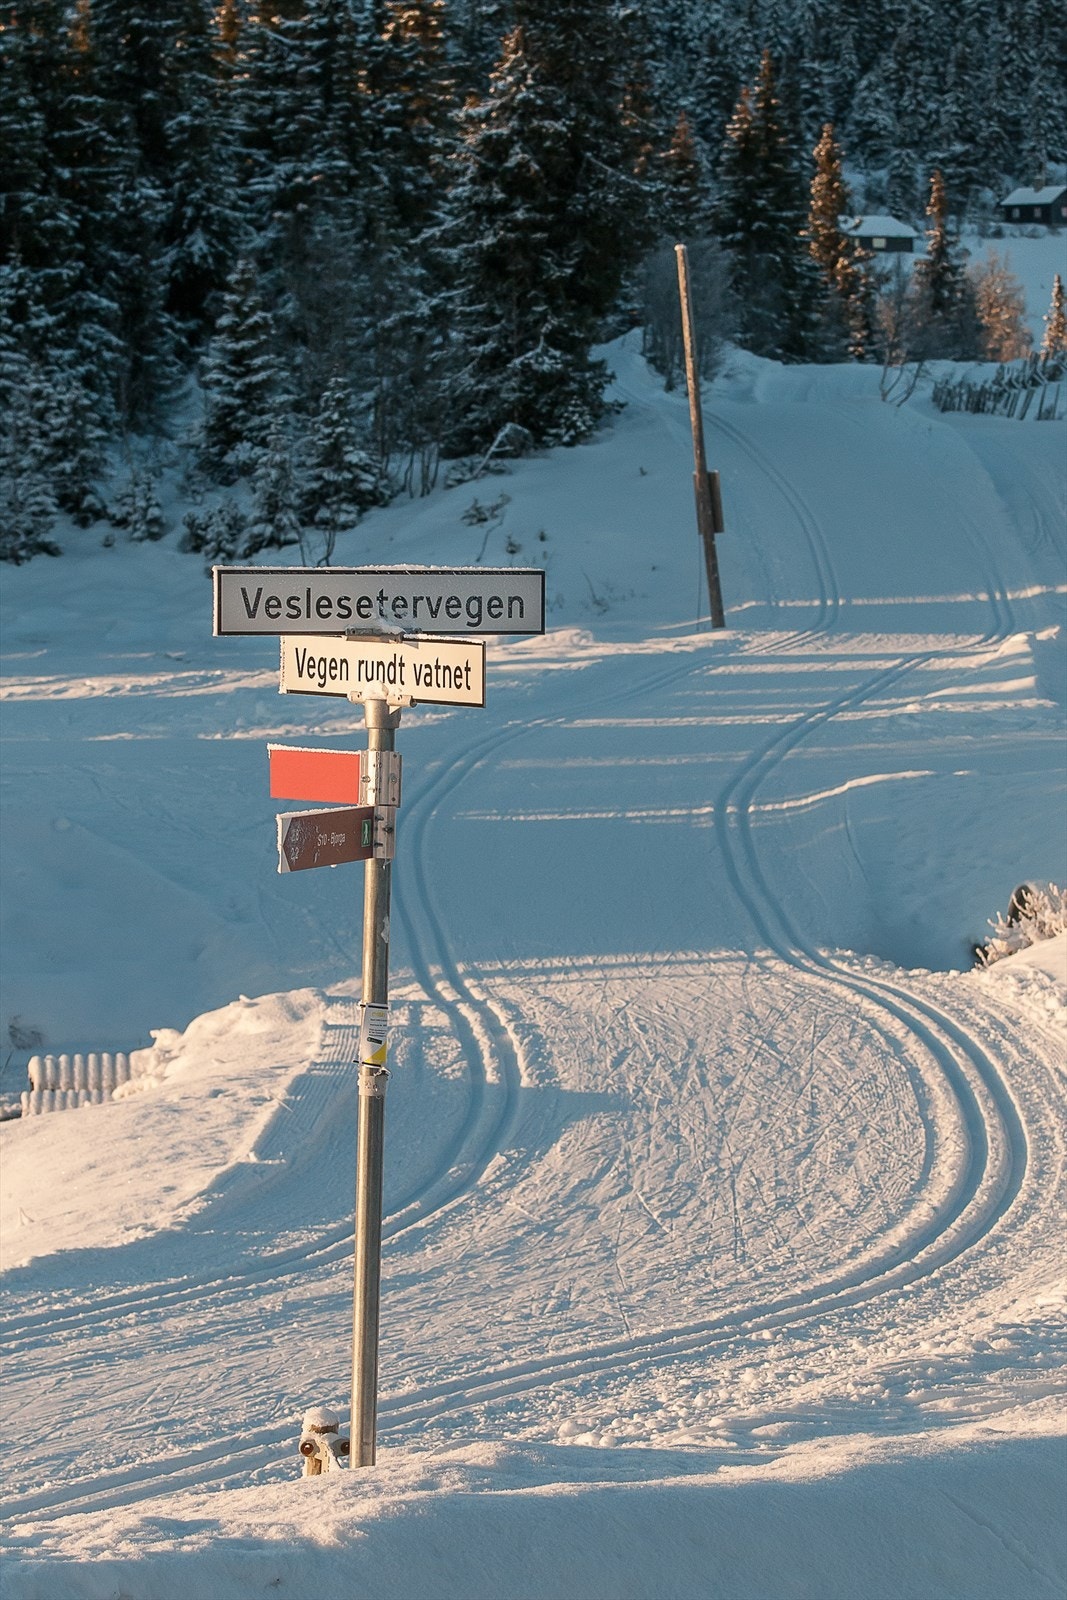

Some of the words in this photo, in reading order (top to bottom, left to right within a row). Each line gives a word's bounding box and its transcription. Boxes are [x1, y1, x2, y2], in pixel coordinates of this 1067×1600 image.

[241, 586, 525, 628] Veslesetervegen
[295, 647, 349, 688] Vegen
[357, 653, 406, 683] rundt
[413, 657, 471, 690] vatnet
